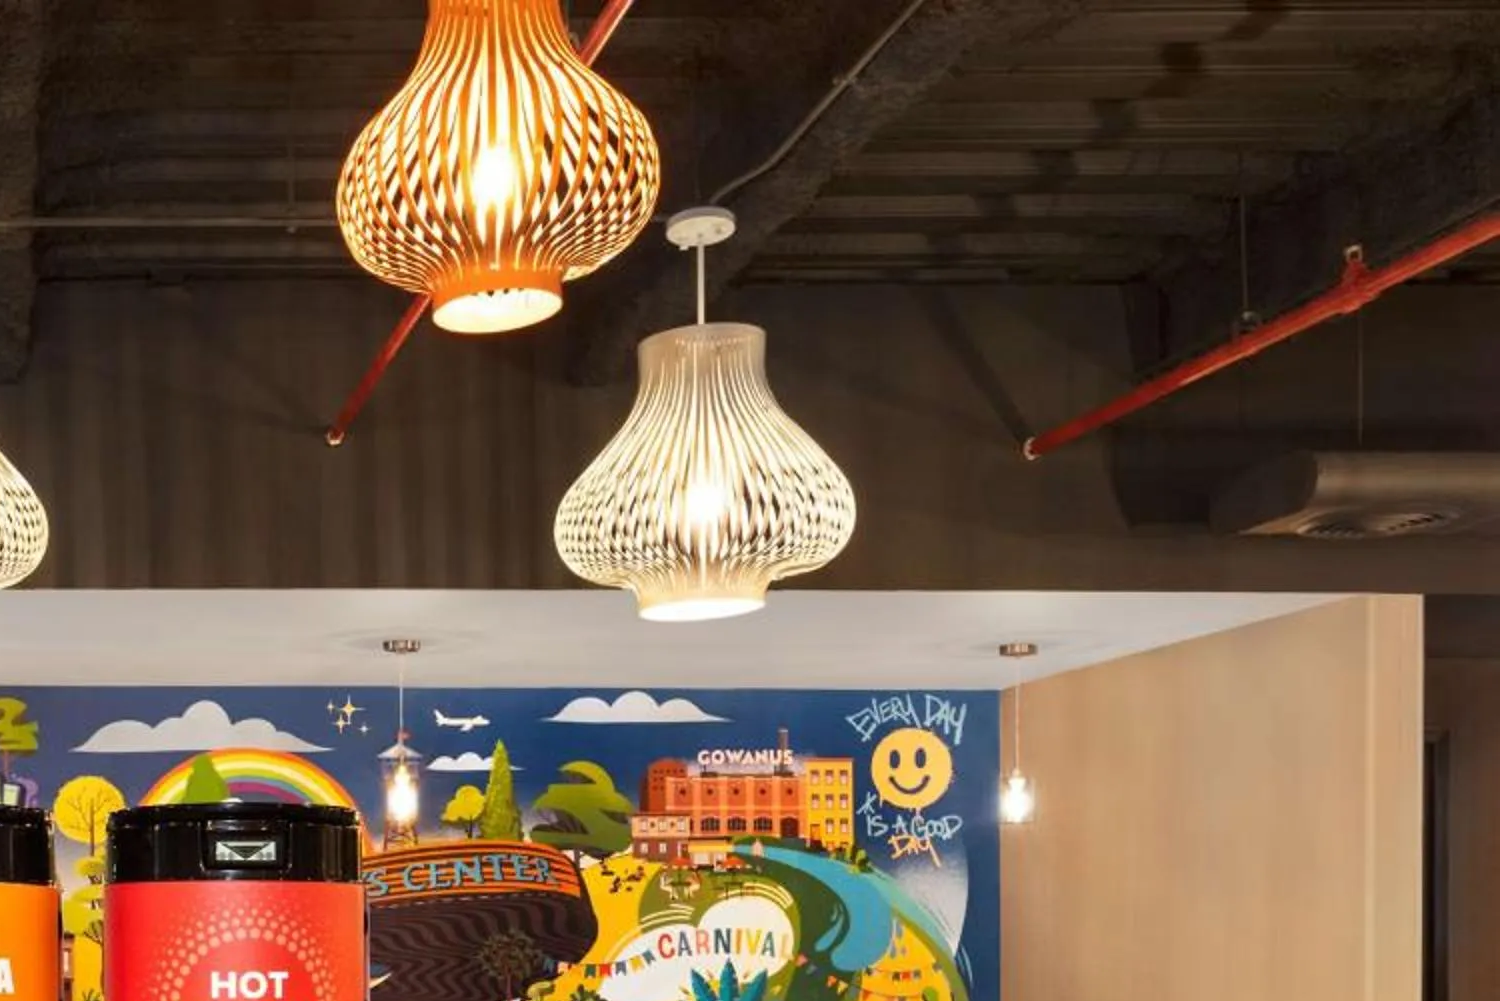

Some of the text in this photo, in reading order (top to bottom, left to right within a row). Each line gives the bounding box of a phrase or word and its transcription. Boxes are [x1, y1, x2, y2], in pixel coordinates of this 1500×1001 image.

[923, 694, 967, 745] DAY
[697, 749, 794, 765] GOWANUS
[867, 815, 889, 837] IS
[911, 814, 963, 841] GOOD
[403, 853, 560, 891] CENTER
[657, 928, 794, 960] CARNIVAL
[211, 971, 289, 999] HOT
